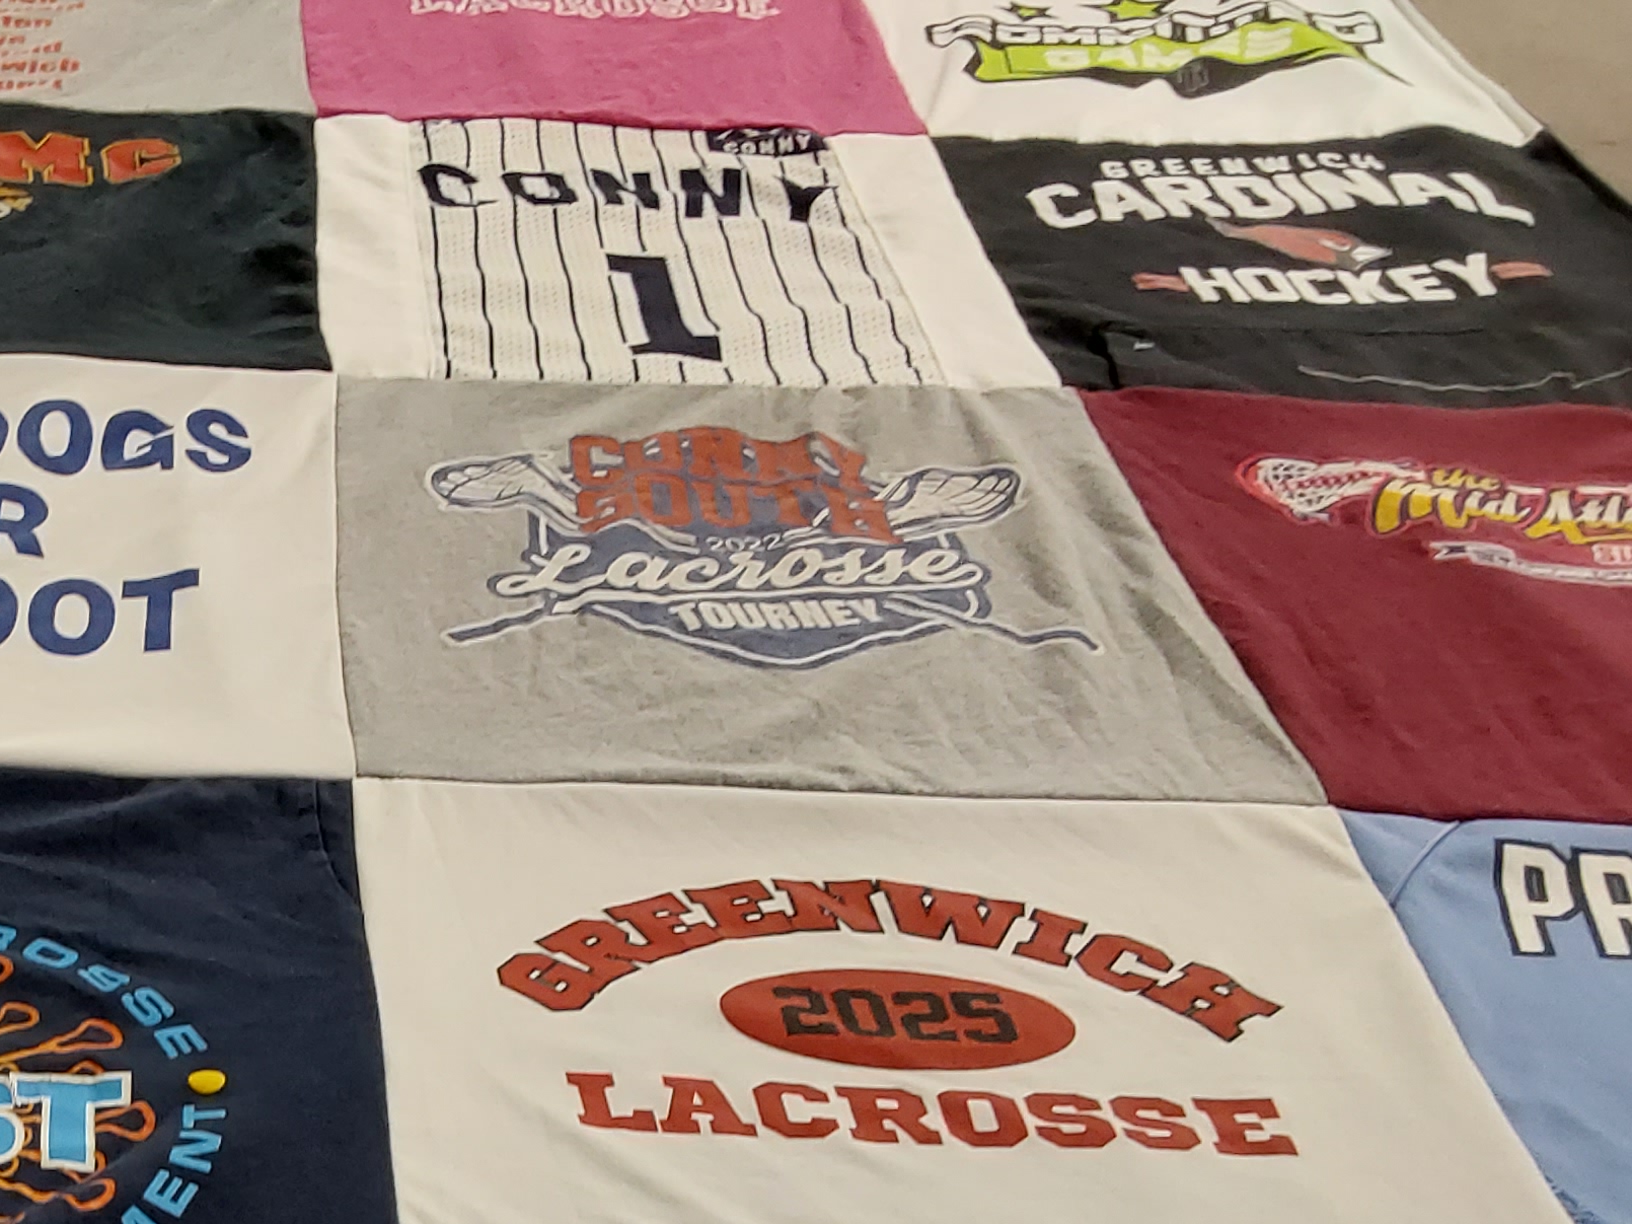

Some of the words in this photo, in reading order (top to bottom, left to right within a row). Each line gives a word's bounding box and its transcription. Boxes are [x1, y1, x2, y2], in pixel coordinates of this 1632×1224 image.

[419, 163, 840, 222] CONNY
[1101, 152, 1384, 180] GREENWICH
[1026, 170, 1536, 229] CARDINAL
[605, 253, 723, 362] 1
[1179, 253, 1500, 305] HOCKEY
[1372, 478, 1532, 534] Mid
[1524, 489, 1632, 545] Atl
[498, 546, 983, 597] Lacrosse
[670, 598, 885, 633] TOURNEY
[496, 878, 1285, 1044] GREENWICH
[771, 983, 1021, 1046] 2025
[566, 1072, 1300, 1158] LACROSSE
